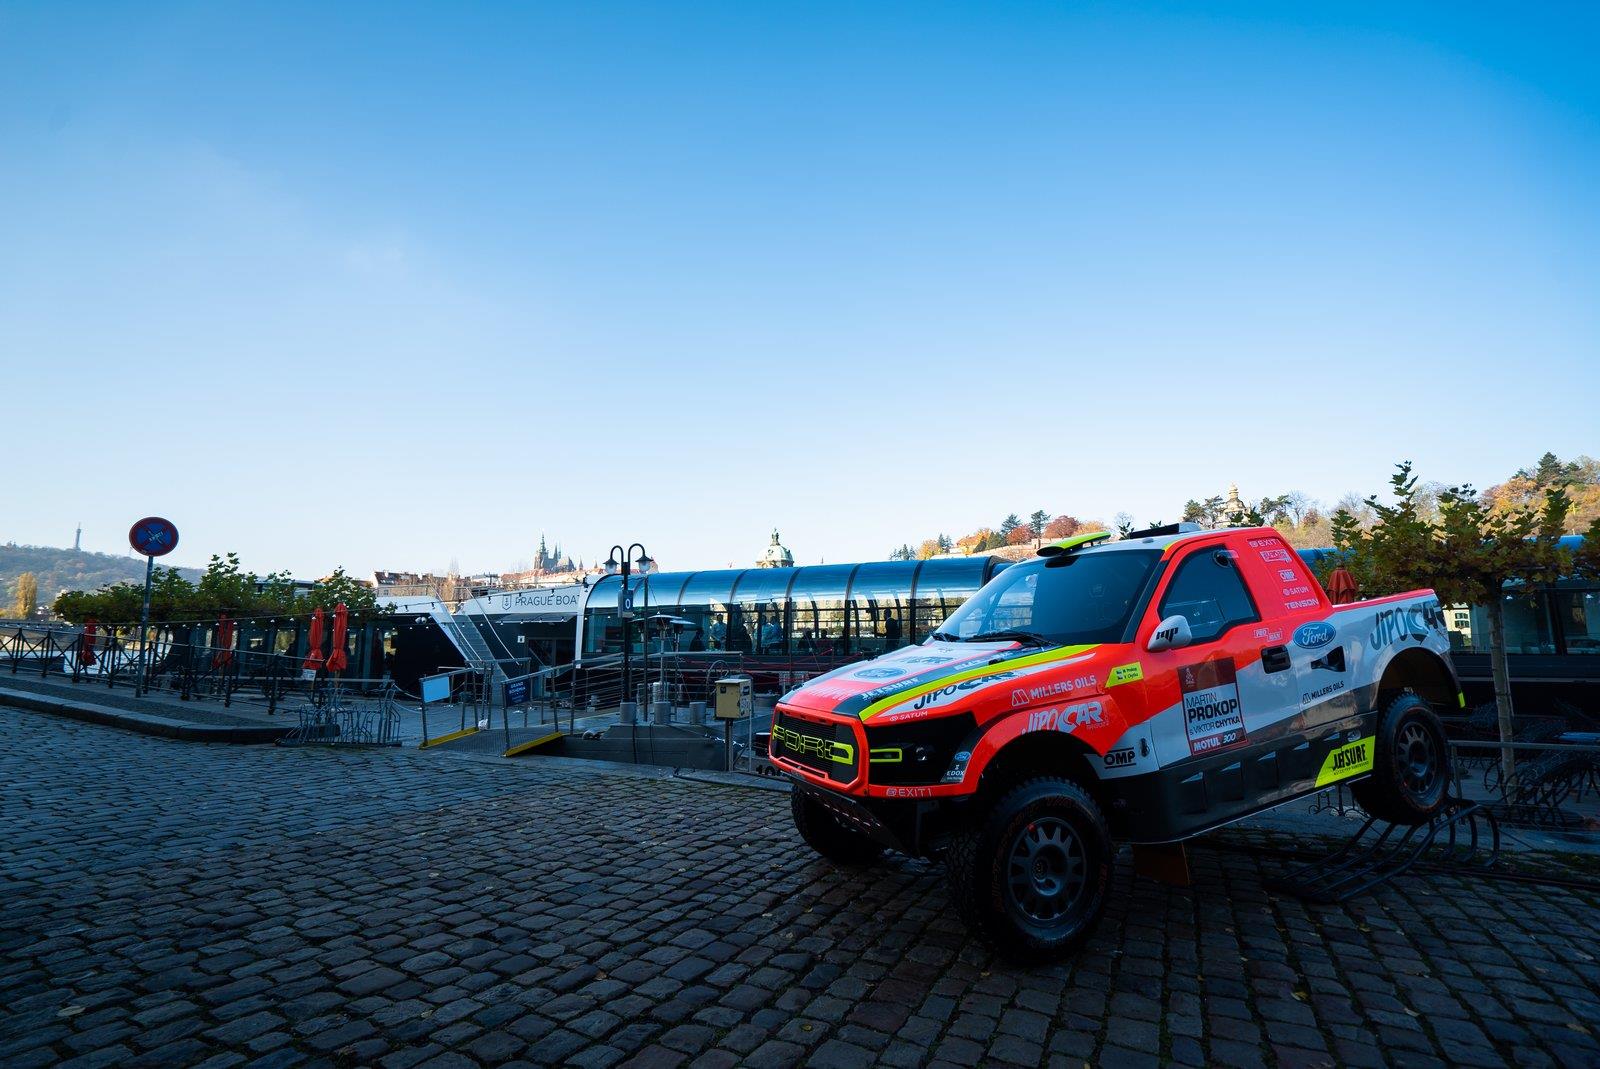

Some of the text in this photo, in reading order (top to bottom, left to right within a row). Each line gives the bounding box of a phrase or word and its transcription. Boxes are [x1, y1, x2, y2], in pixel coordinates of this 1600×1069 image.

[515, 597, 552, 606] PRAGUE
[1030, 675, 1097, 700] MILLERS OILS
[1311, 681, 1345, 700] MILLERS OILS
[1186, 692, 1218, 708] MARTIN
[899, 711, 928, 721] SATUM
[1187, 699, 1238, 723] PROKOP
[771, 724, 854, 766] FORD
[1193, 736, 1221, 751] MOTUL
[1103, 750, 1136, 766] OMP
